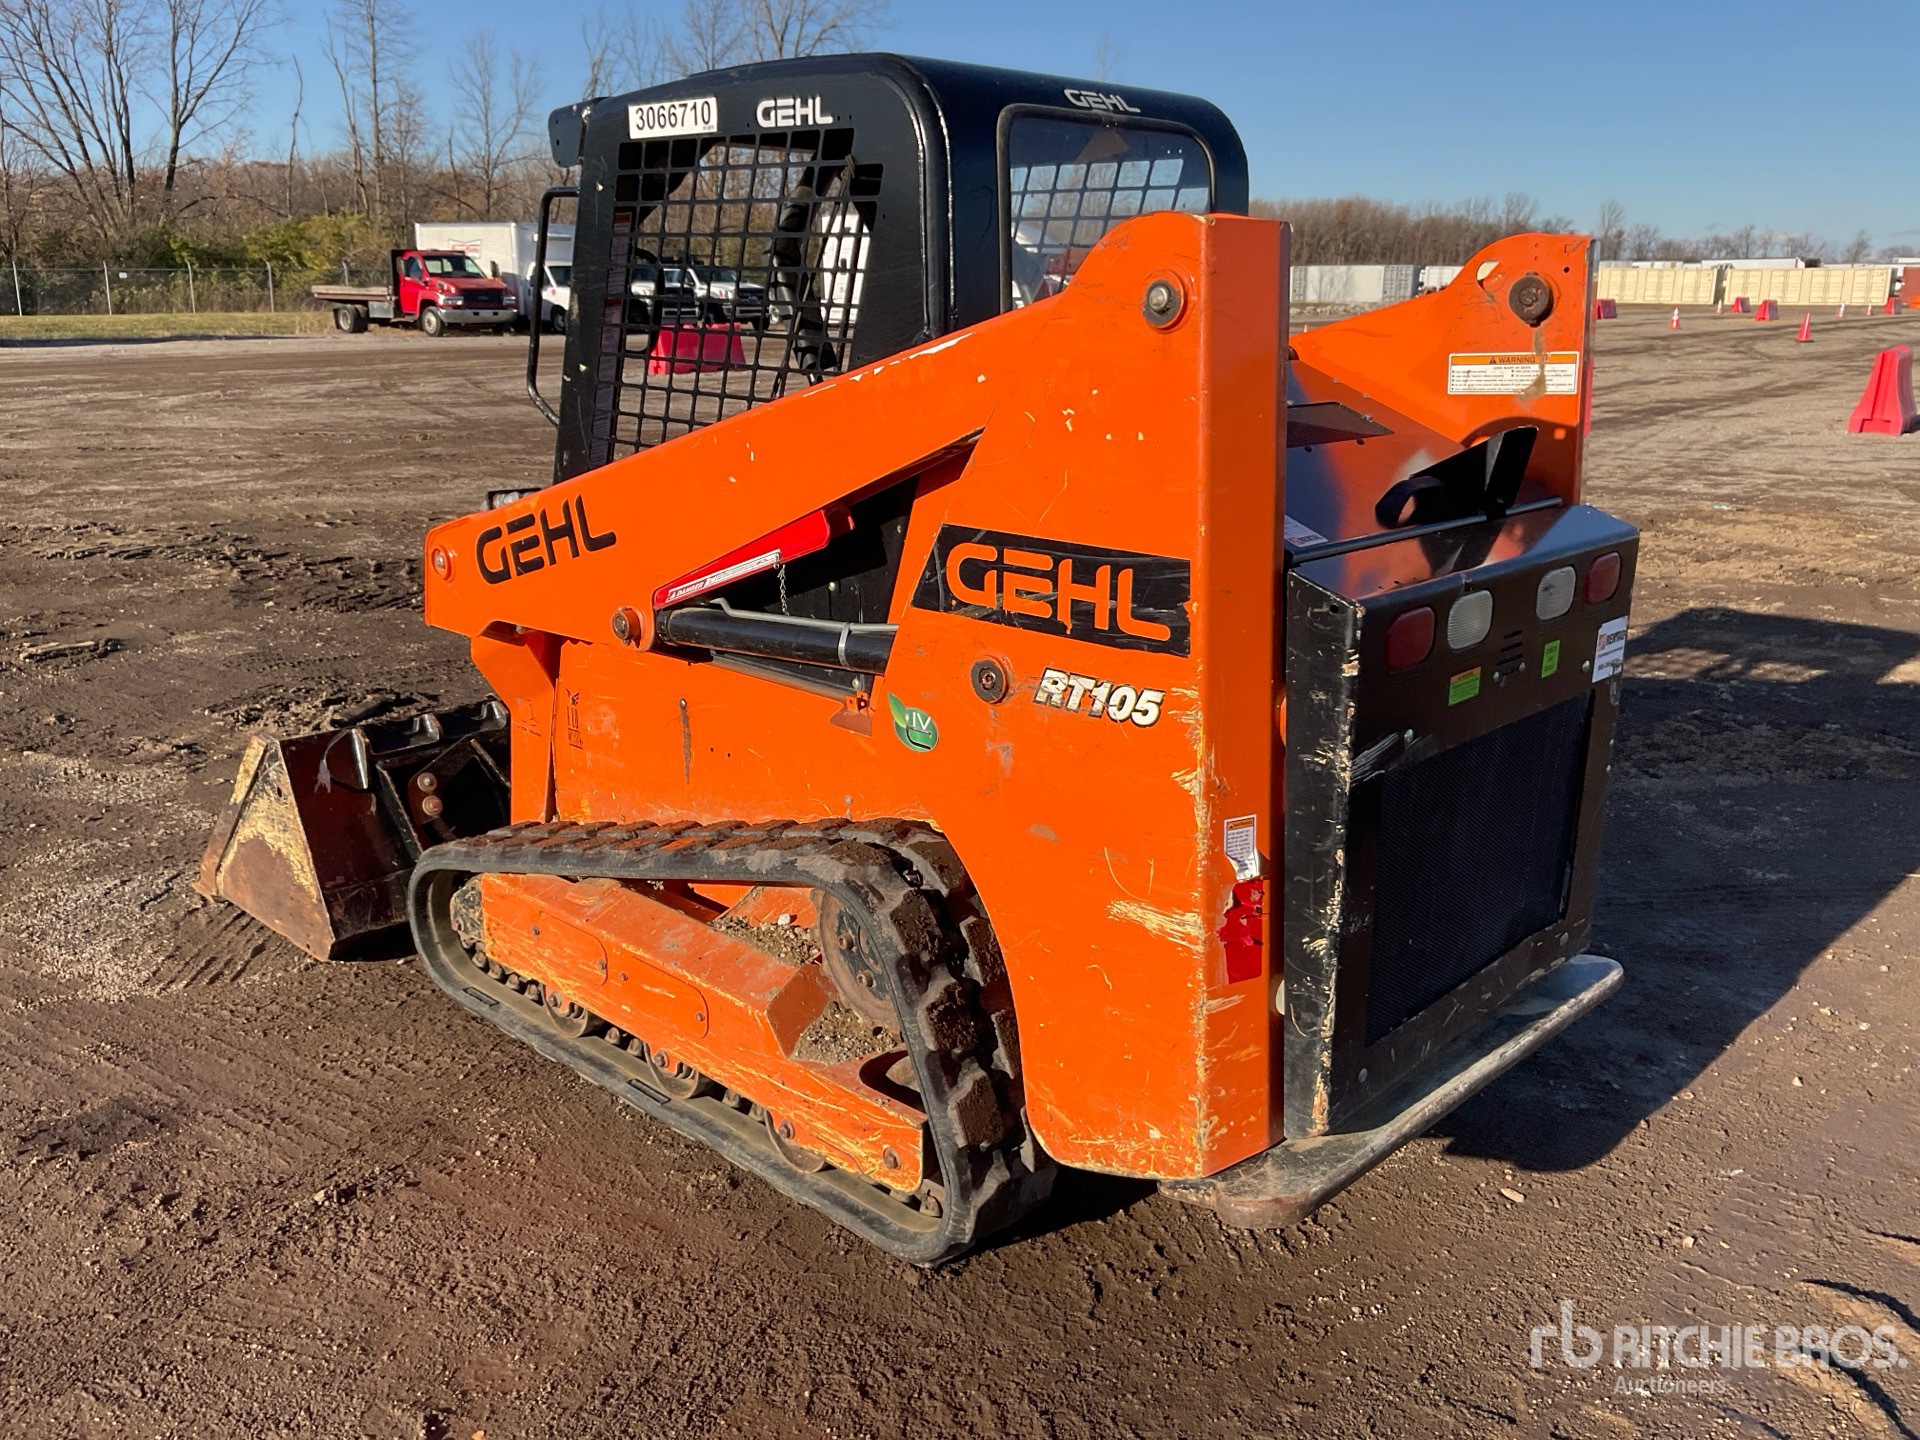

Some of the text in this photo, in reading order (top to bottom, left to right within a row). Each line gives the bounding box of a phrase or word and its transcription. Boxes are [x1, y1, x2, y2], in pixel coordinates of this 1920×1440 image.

[635, 101, 711, 131] 3066710
[757, 96, 834, 128] GEHL
[1064, 89, 1141, 113] GEHL
[1498, 356, 1536, 364] WARNING
[476, 494, 617, 584] GEHL
[946, 543, 1171, 642] GEHL
[1033, 667, 1165, 728] RT105
